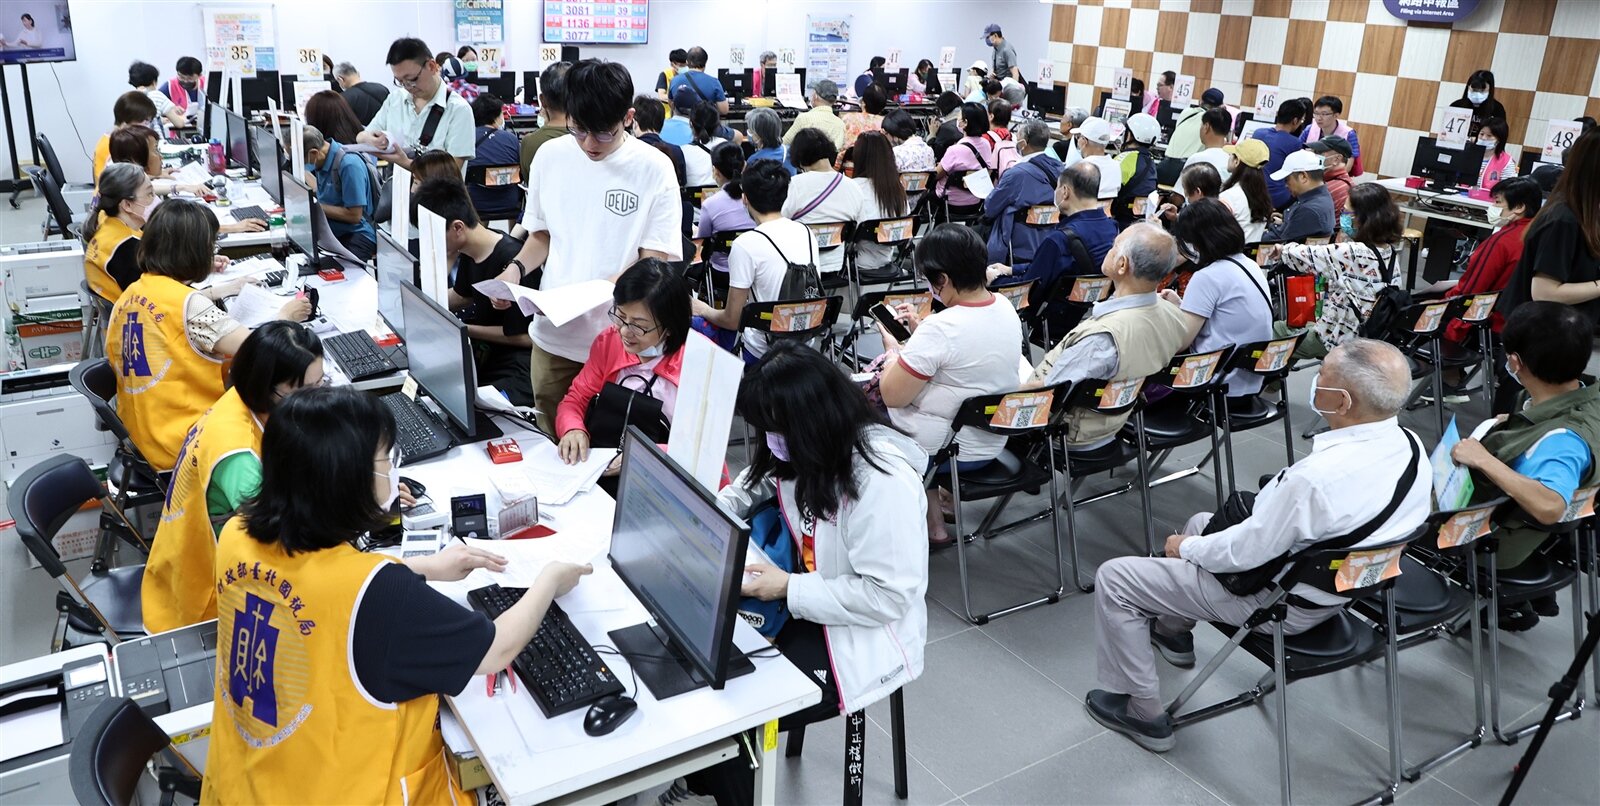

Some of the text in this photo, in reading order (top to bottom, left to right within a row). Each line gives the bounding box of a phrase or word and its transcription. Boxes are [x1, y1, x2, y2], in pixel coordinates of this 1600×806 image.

[566, 5, 589, 15] 3081
[617, 7, 628, 15] 39
[1400, 8, 1413, 16] Filing
[567, 19, 589, 28] 1136
[618, 20, 627, 28] 13
[565, 31, 589, 40] 3077
[231, 45, 249, 60] 35
[299, 49, 316, 63] 36
[481, 48, 496, 62] 37
[542, 48, 557, 61] 38
[731, 51, 745, 64] 39
[780, 51, 794, 64] 40
[889, 52, 899, 63] 41
[943, 53, 954, 64] 42
[1040, 67, 1052, 79] 43
[1116, 77, 1128, 88] 44
[1176, 84, 1190, 97] 45
[1260, 95, 1275, 108] 46
[1445, 117, 1466, 133] 47
[1551, 131, 1573, 149] 48
[608, 193, 635, 212] DEUS
